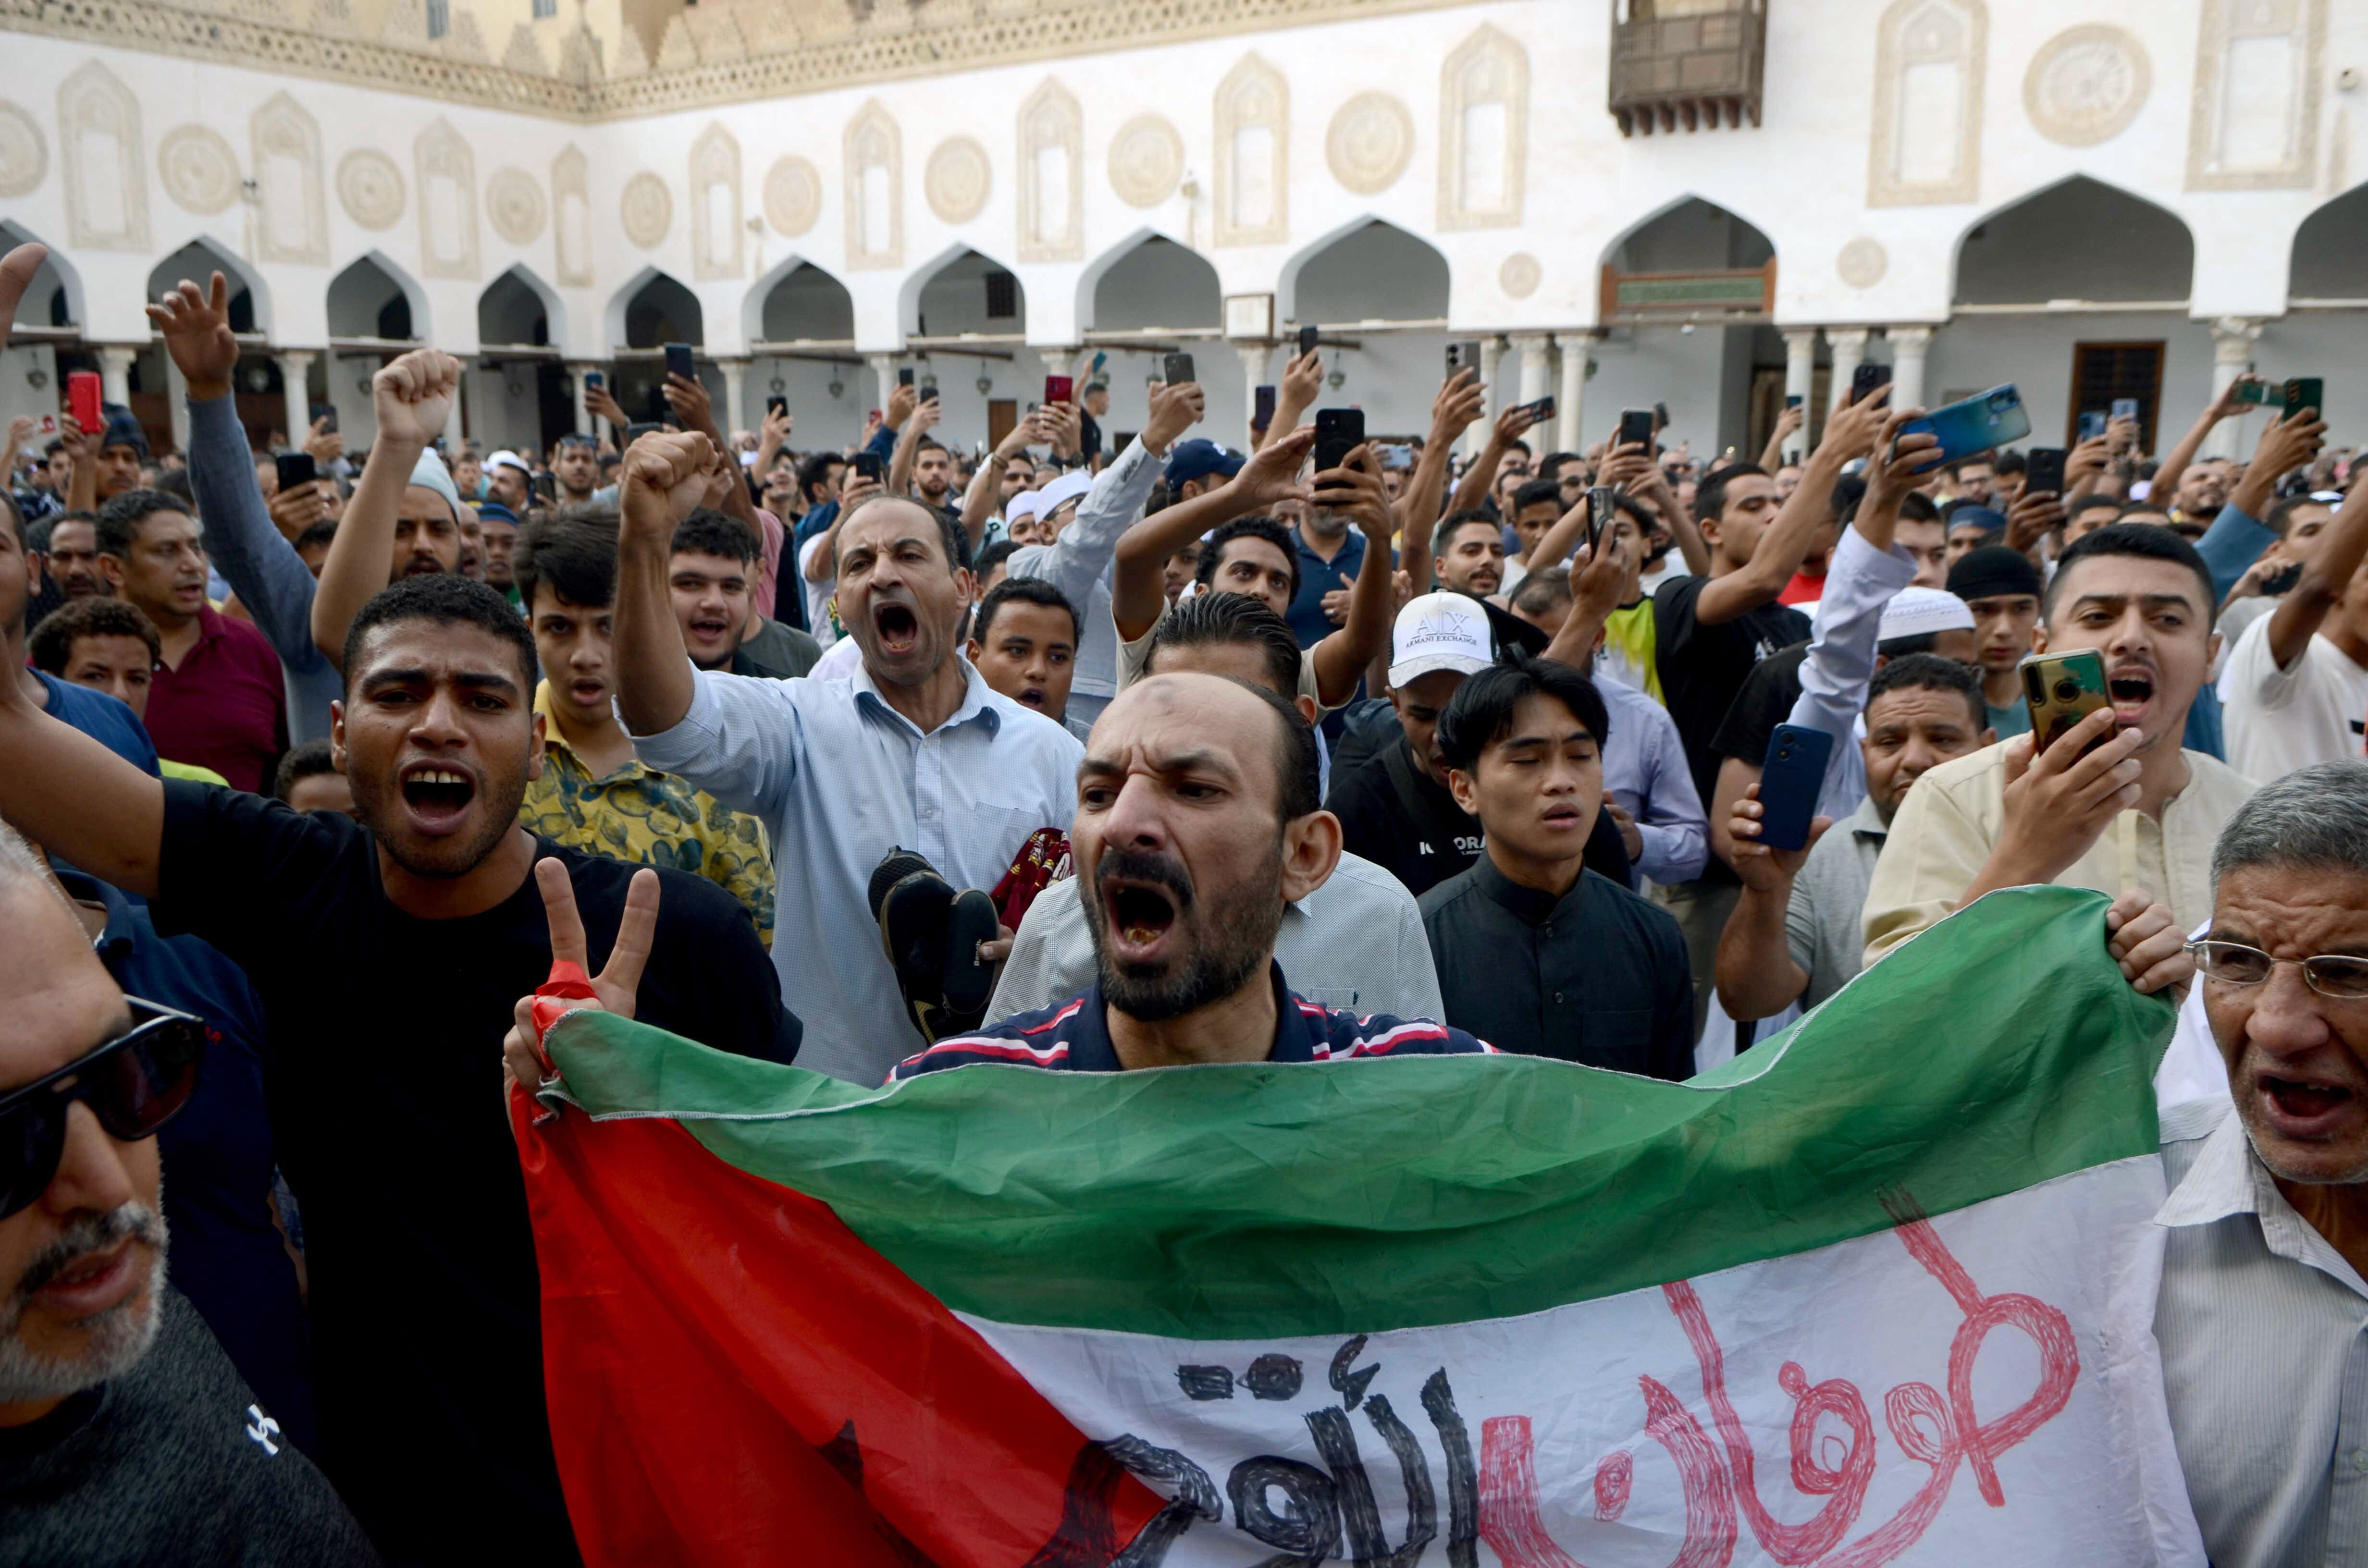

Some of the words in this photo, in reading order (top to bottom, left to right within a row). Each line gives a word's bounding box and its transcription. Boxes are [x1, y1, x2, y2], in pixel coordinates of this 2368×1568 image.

[1406, 636, 1434, 649] ARMANI
[1437, 635, 1478, 646] EXCHANGE
[817, 1334, 1479, 1568] الأقص
[1478, 1182, 2080, 1568] طوفان
